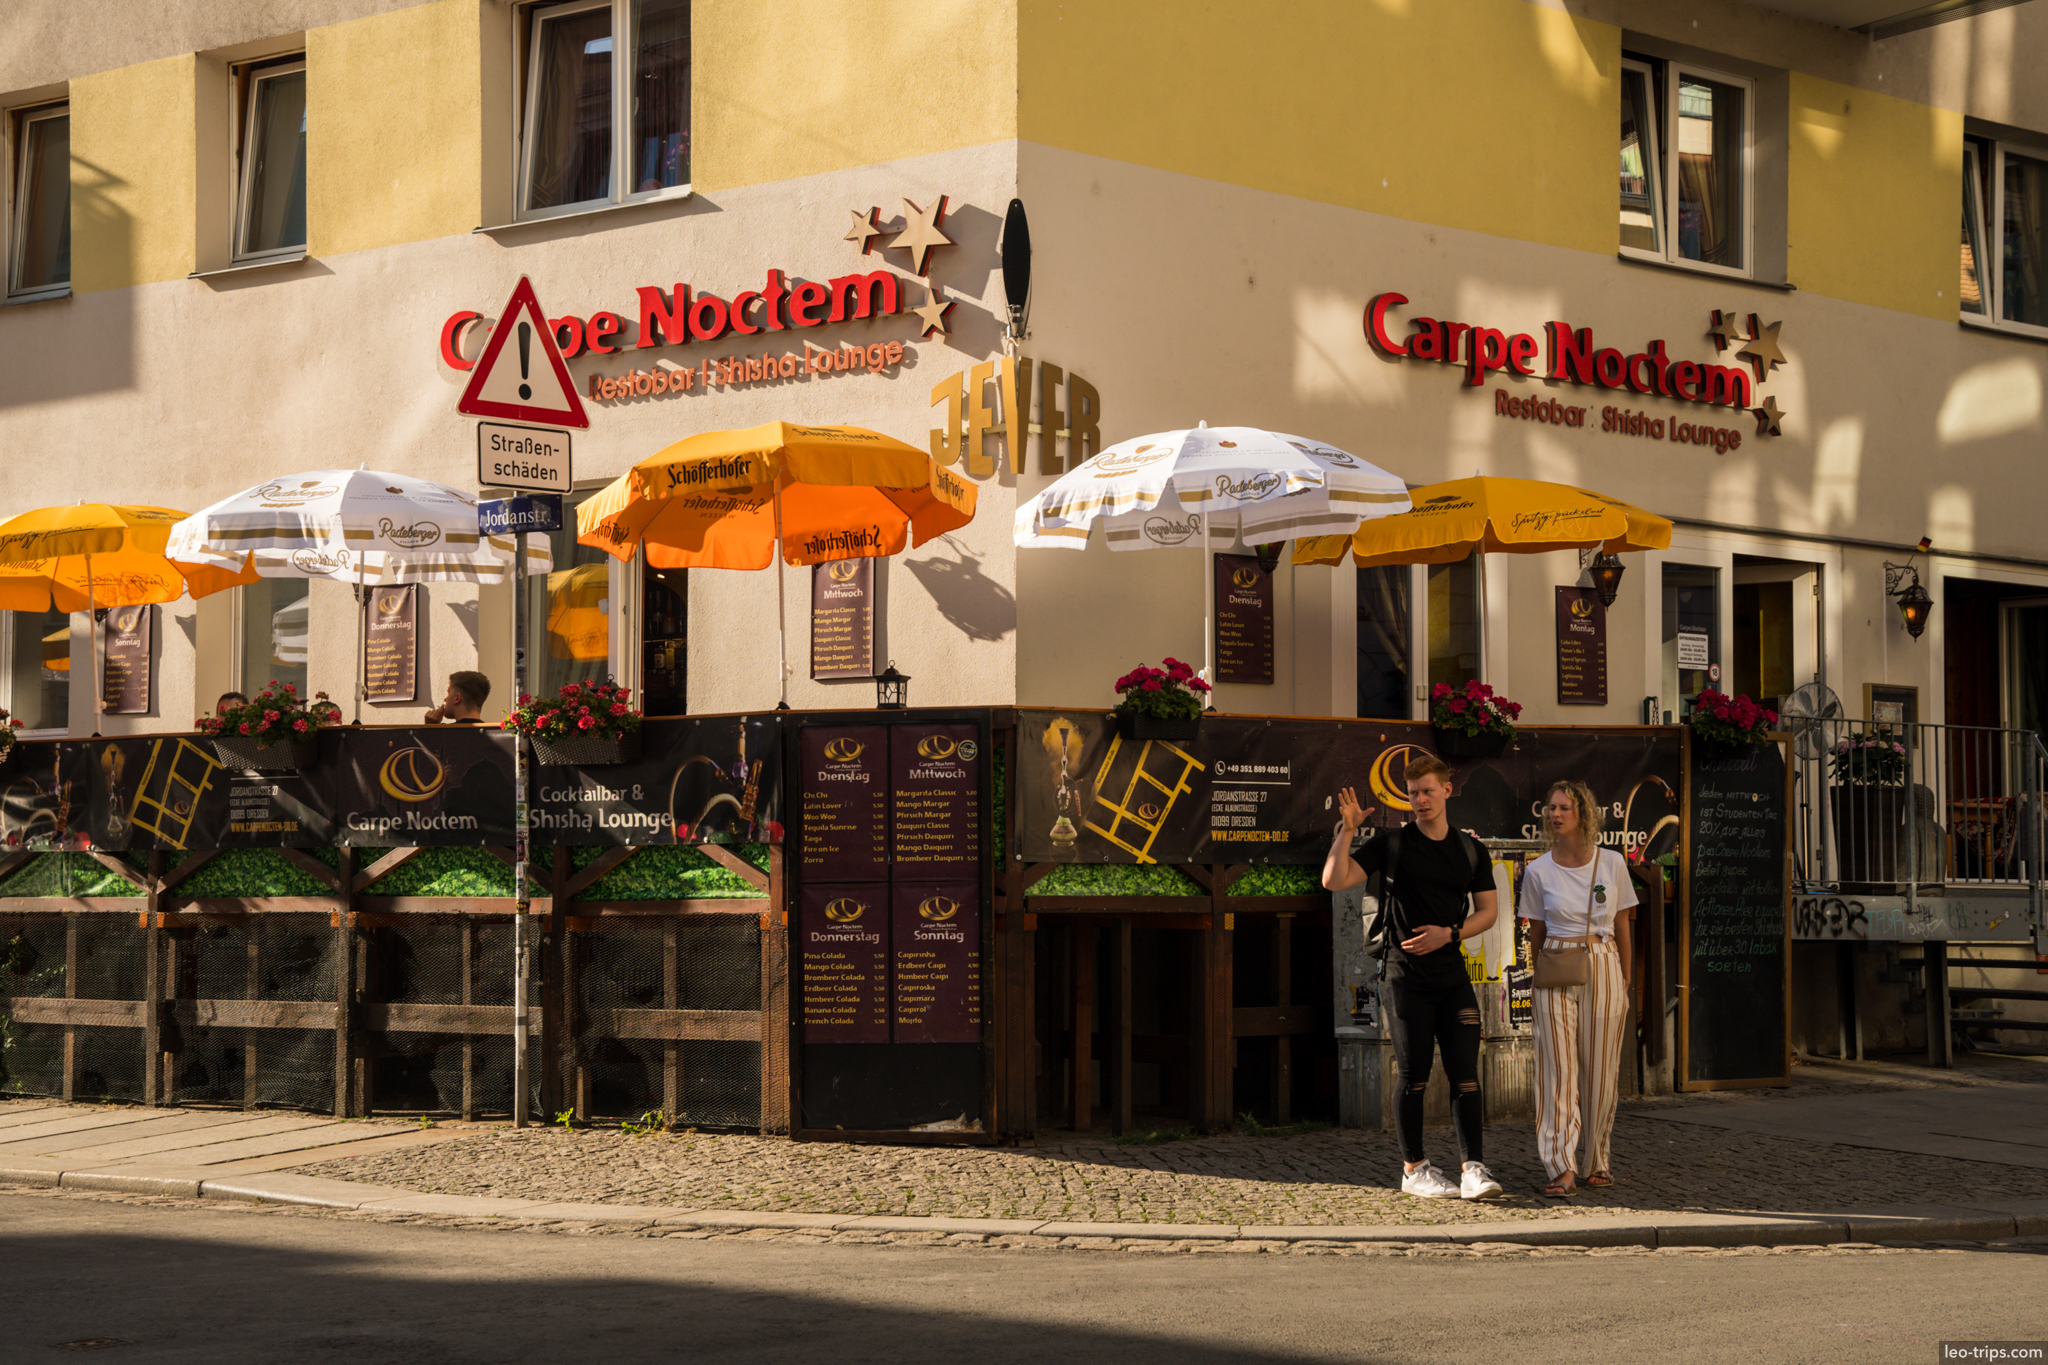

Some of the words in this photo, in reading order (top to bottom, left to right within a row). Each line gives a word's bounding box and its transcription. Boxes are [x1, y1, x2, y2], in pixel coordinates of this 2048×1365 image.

[440, 310, 626, 371] Cpe
[636, 268, 904, 348] Noctem
[1364, 292, 1539, 386] Carpe
[1545, 320, 1751, 407] Noctem
[589, 366, 695, 401] Restobar
[716, 353, 796, 386] Shisha
[805, 340, 904, 374] Lounge
[930, 356, 1100, 475] JEVER
[1495, 389, 1587, 427] Restobar
[1602, 406, 1665, 439] Shisha
[1670, 416, 1741, 453] Lounge
[491, 434, 560, 456] Straßen-
[494, 460, 558, 481] schäden
[667, 456, 752, 489] Schöfferhofer
[1216, 474, 1279, 498] Radeberger
[485, 508, 551, 527] Jordanstr.
[379, 518, 440, 542] Radeberger
[823, 588, 864, 599] Mittwoch
[1229, 594, 1262, 608] Dienstag
[371, 620, 412, 631] Donnerstag
[1570, 623, 1596, 635] Montag
[115, 639, 141, 647] Sonntag
[818, 770, 869, 783] Dienstag
[910, 769, 965, 778] Mittwoch
[1240, 765, 1252, 773] 351
[1280, 766, 1288, 774] 60
[272, 785, 279, 796] 27
[539, 784, 628, 803] Cocktailbar
[631, 784, 644, 801] &
[1212, 790, 1259, 802] JORDANSTRASSE
[1260, 791, 1267, 802] 27
[1726, 791, 1771, 803] MITTWCH
[246, 809, 269, 819] DRESDEN
[1613, 802, 1625, 818] &
[347, 811, 401, 836] Carpe
[406, 810, 478, 831] Noctem
[530, 808, 593, 829] Shisha
[598, 808, 673, 835] Lounge
[1211, 816, 1230, 827] 01099
[1231, 816, 1256, 827] DRESDEN
[1595, 830, 1648, 853] ounge
[811, 932, 879, 944] Donnerstag
[914, 929, 964, 942] Sonntag
[804, 964, 829, 972] Mango
